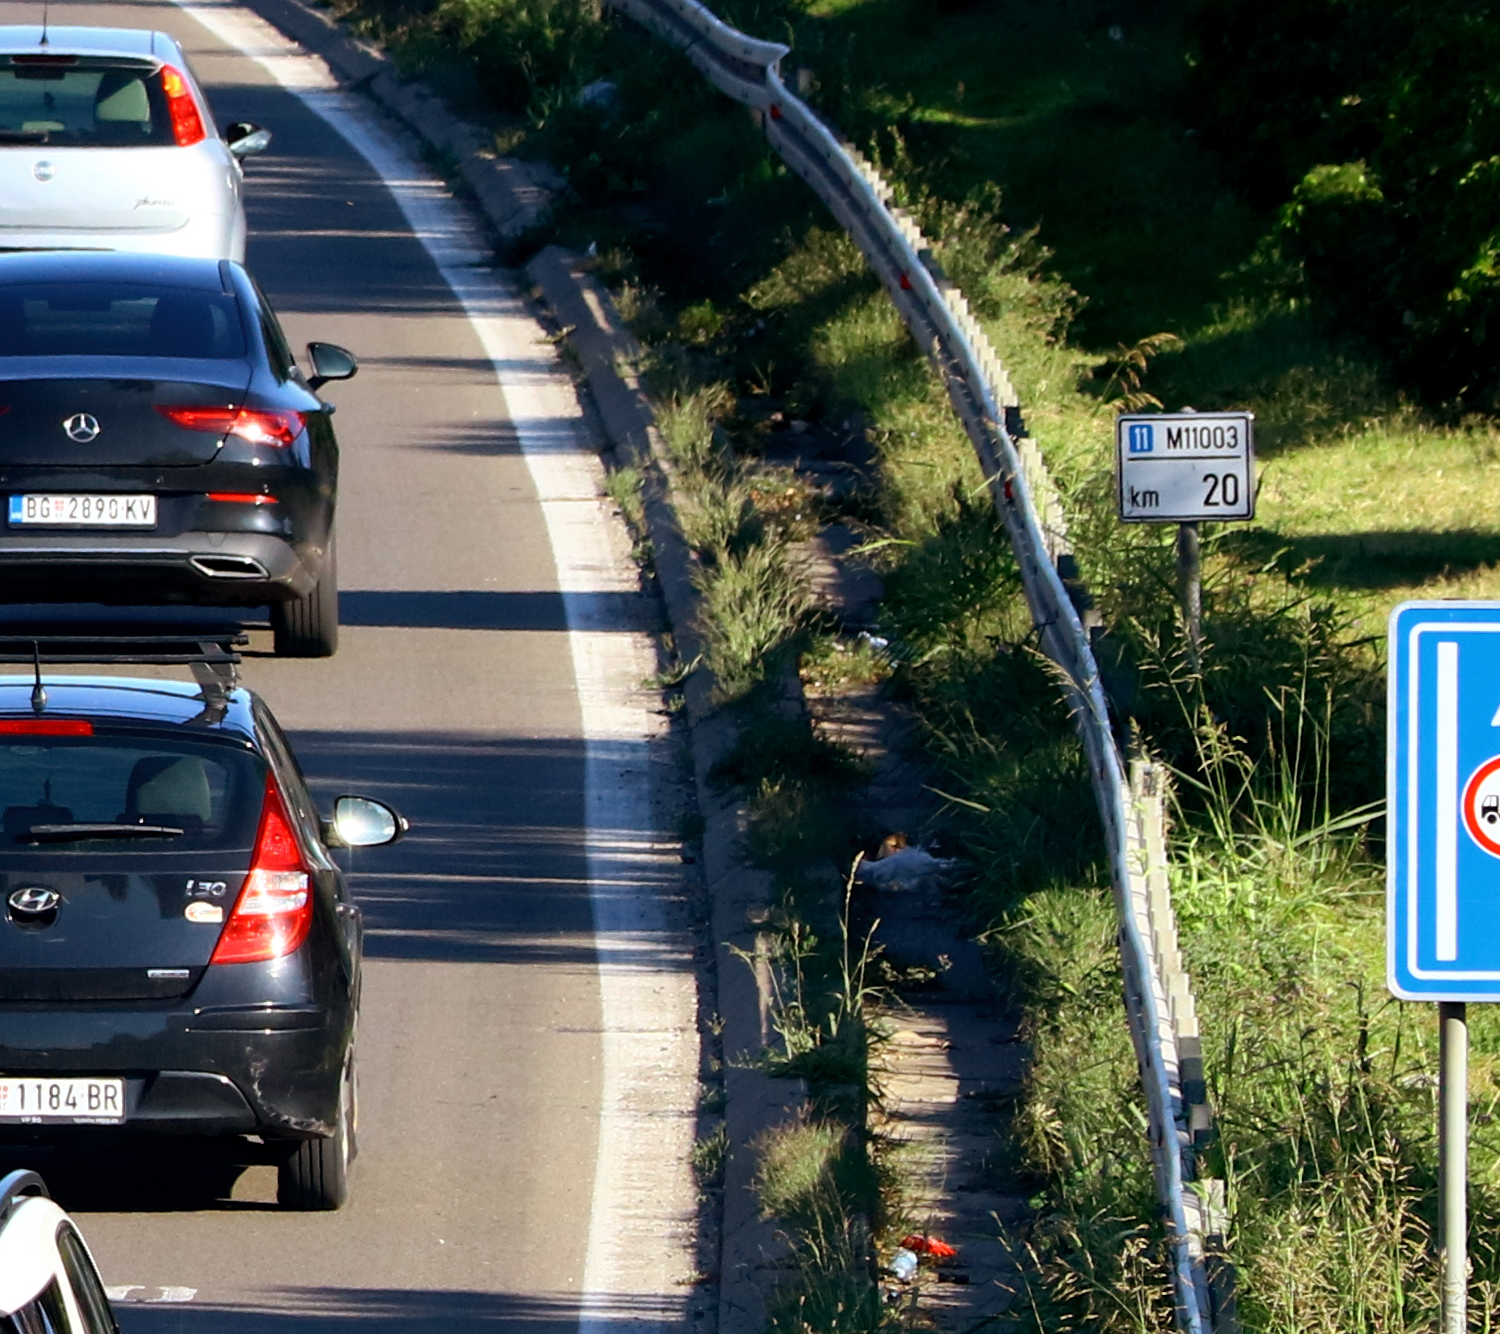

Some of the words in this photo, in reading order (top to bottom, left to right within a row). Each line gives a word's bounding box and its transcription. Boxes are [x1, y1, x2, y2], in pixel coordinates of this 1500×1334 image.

[1134, 427, 1149, 450] 11
[1166, 425, 1239, 450] M11003
[1130, 485, 1160, 508] km
[1202, 473, 1239, 507] 20
[27, 497, 51, 519] BG
